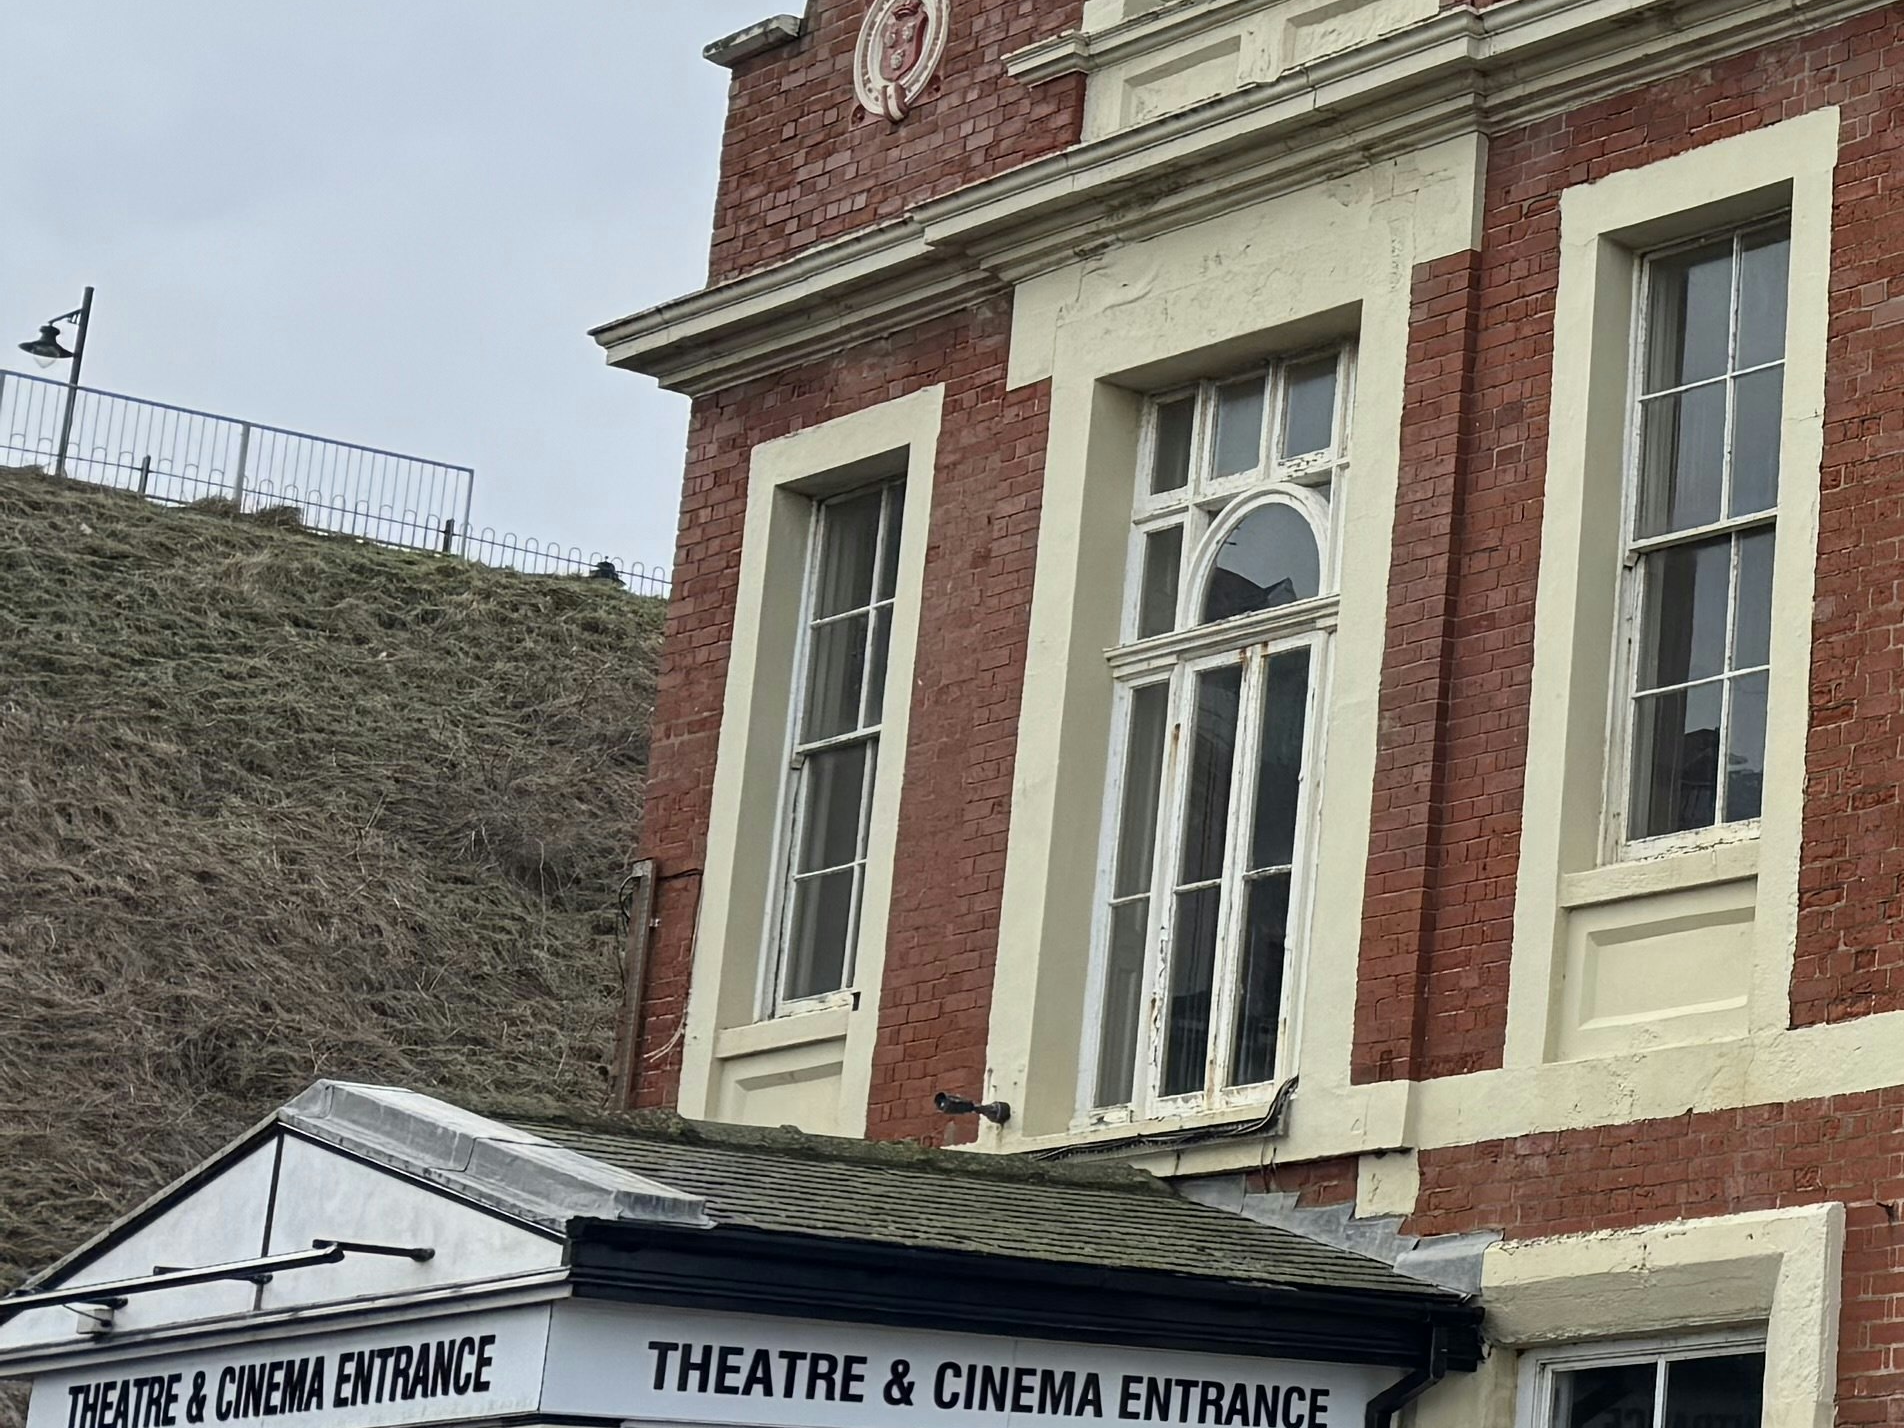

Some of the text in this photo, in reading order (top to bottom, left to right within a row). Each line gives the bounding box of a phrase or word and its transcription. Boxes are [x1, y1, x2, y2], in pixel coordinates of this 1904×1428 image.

[186, 1371, 206, 1424] &
[216, 1356, 324, 1421] CINEMA
[333, 1335, 496, 1408] ENTRANCE
[648, 1341, 867, 1402] THEATRE
[884, 1359, 915, 1406] &
[934, 1362, 1102, 1417] CINEMA
